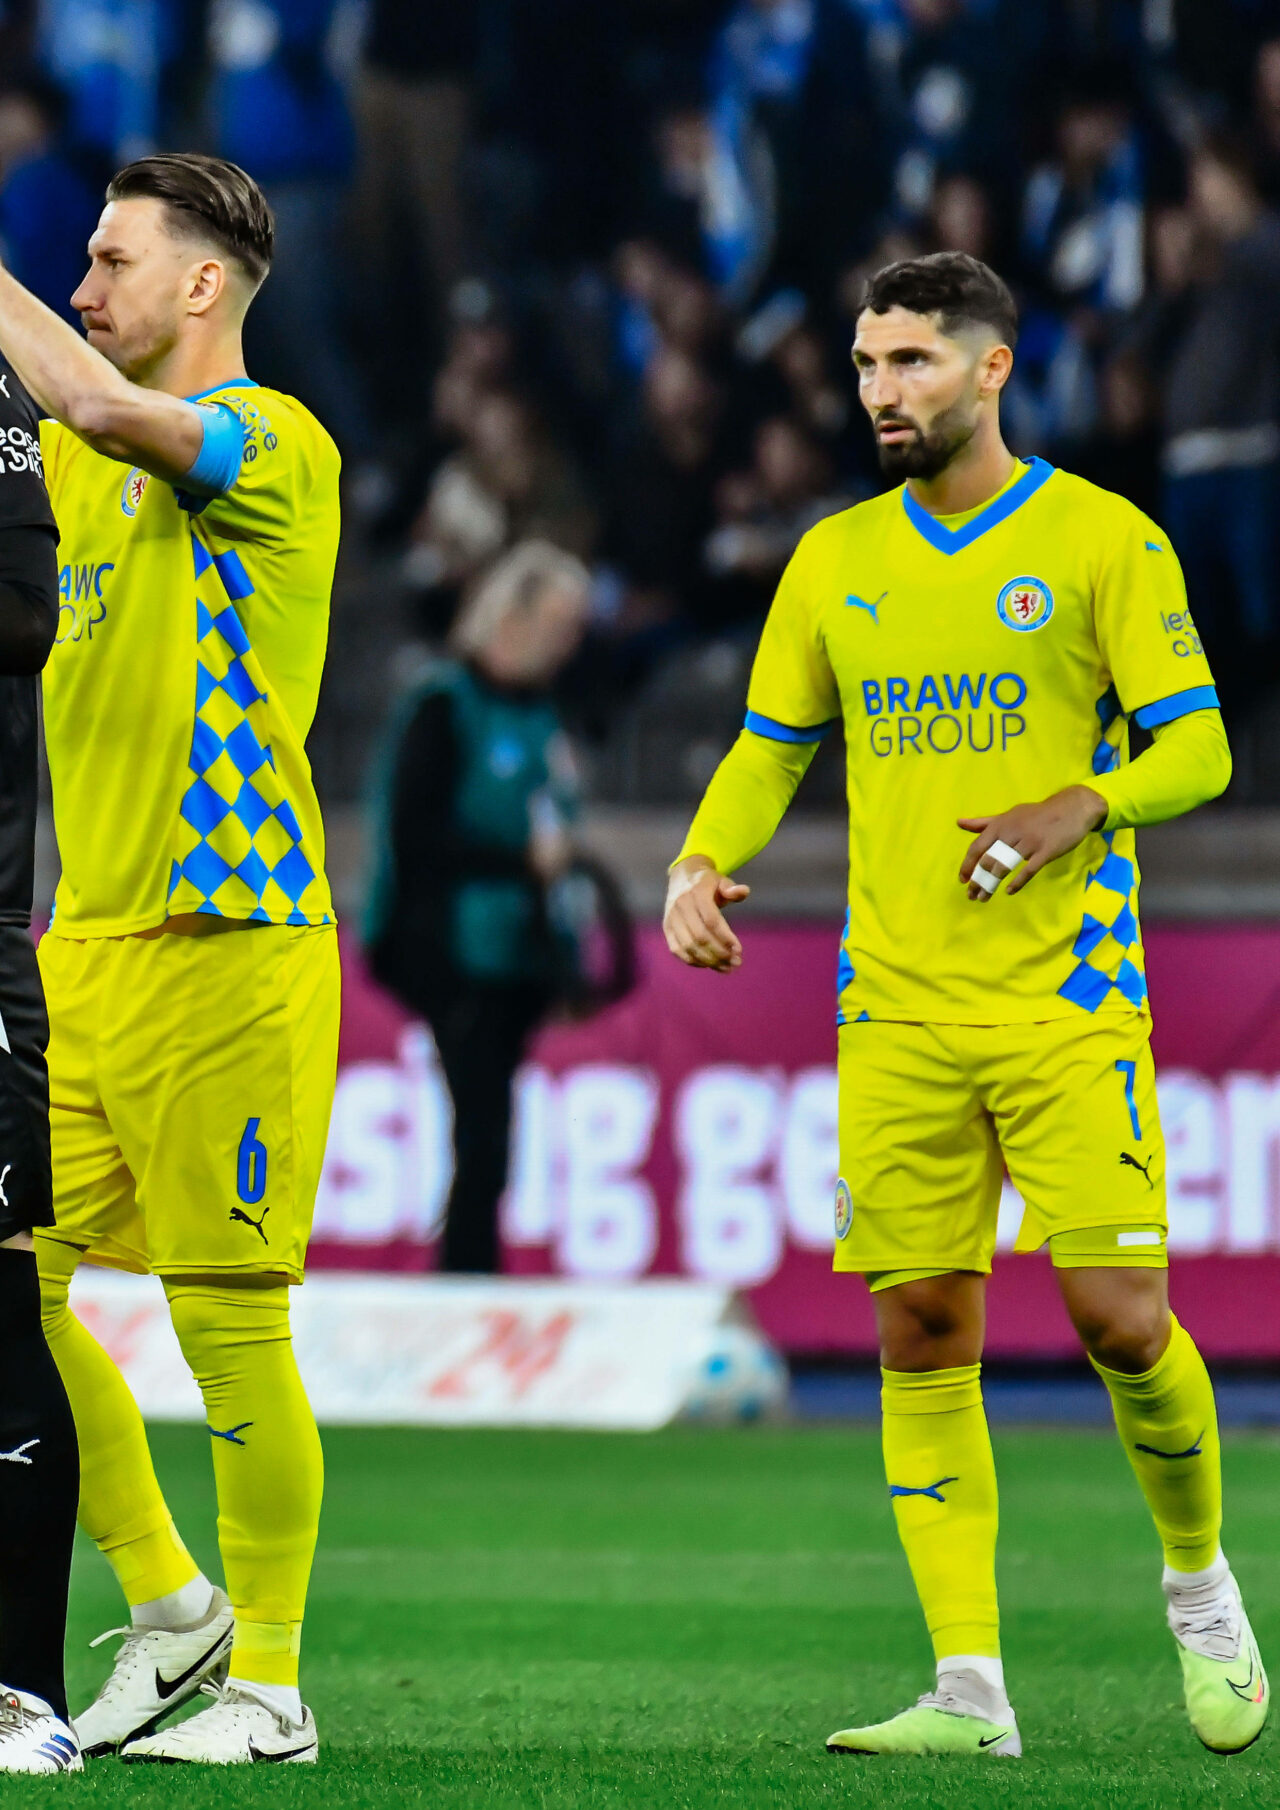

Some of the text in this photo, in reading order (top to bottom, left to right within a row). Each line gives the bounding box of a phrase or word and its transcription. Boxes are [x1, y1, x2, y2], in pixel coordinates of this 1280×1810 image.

[862, 672, 1028, 716] BRAWO
[870, 713, 1026, 757] GROUP
[1114, 1059, 1142, 1141] 7
[237, 1117, 267, 1204] 6
